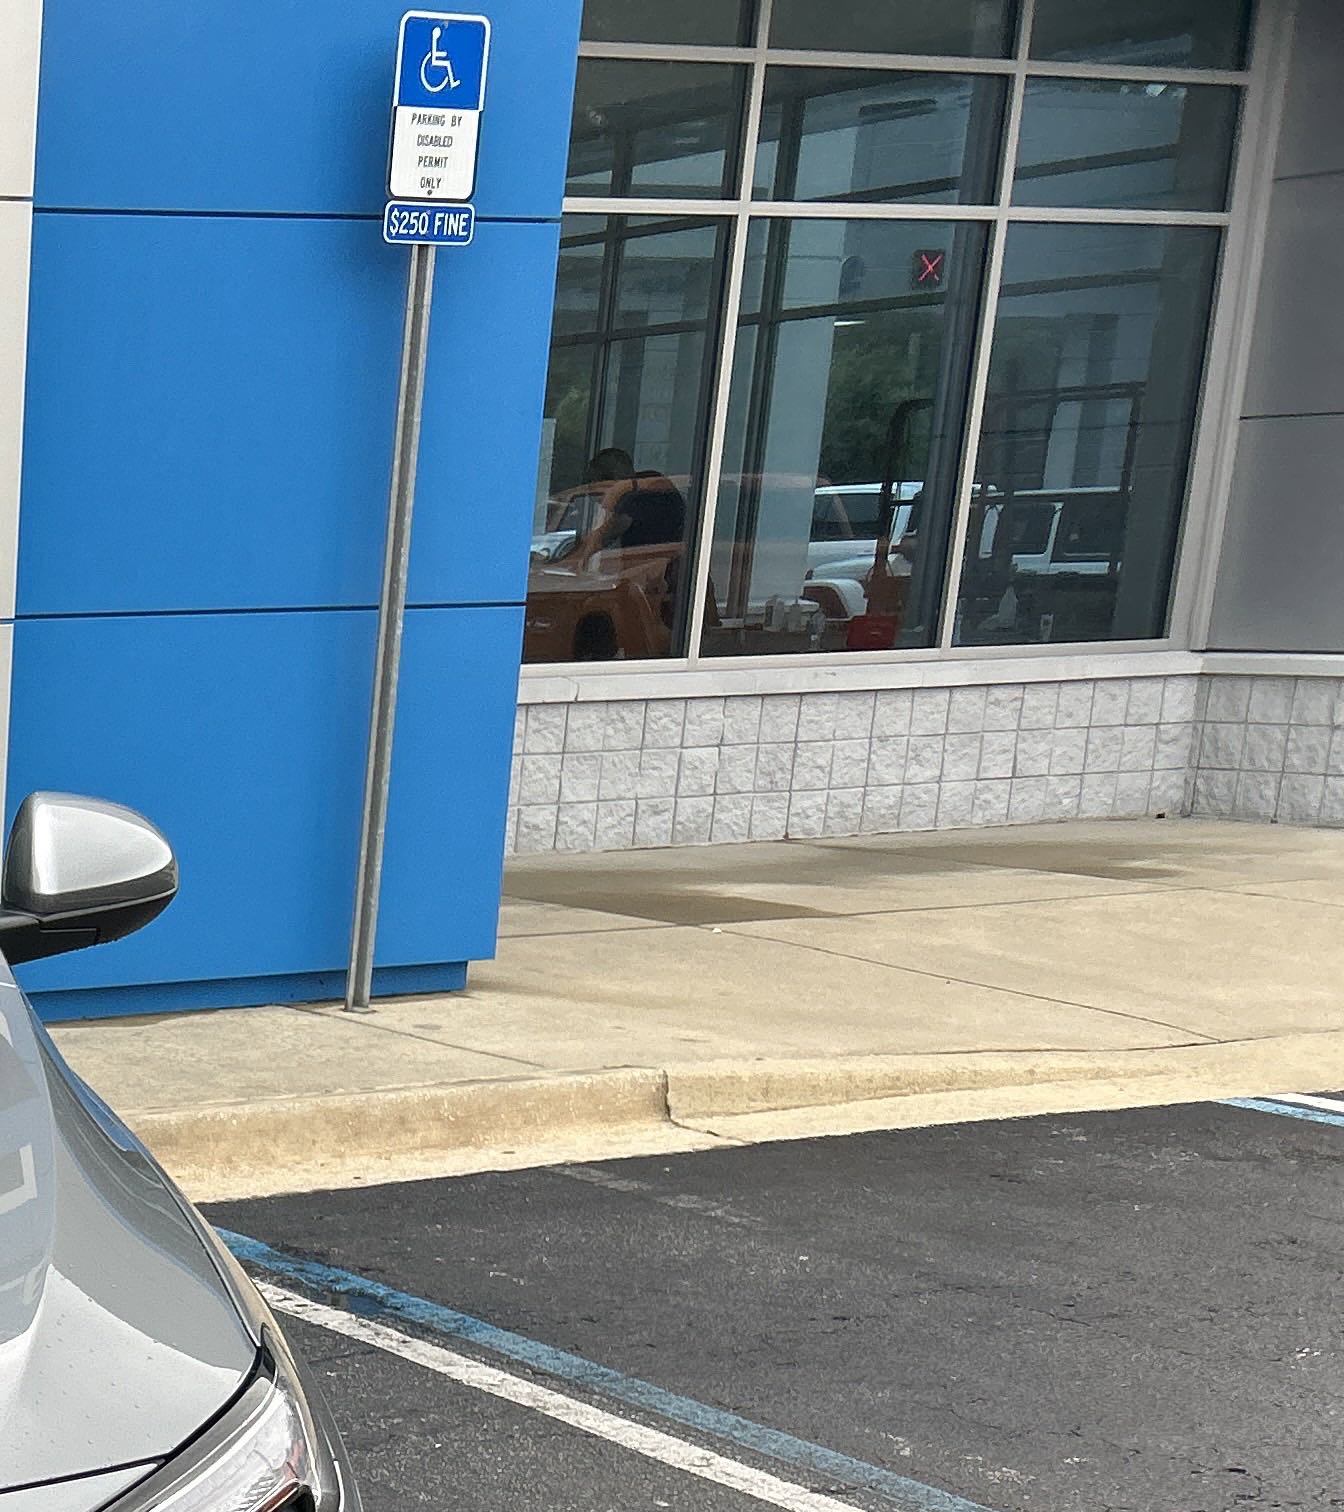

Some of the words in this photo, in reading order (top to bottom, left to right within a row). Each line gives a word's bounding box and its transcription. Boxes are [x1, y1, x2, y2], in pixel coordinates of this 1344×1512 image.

[411, 113, 446, 127] PARKING
[450, 115, 463, 127] BY
[416, 134, 453, 148] DISABLED
[417, 156, 449, 169] PERMIT
[420, 176, 442, 189] ONLY
[389, 207, 429, 237] $250
[433, 212, 470, 237] FINE
